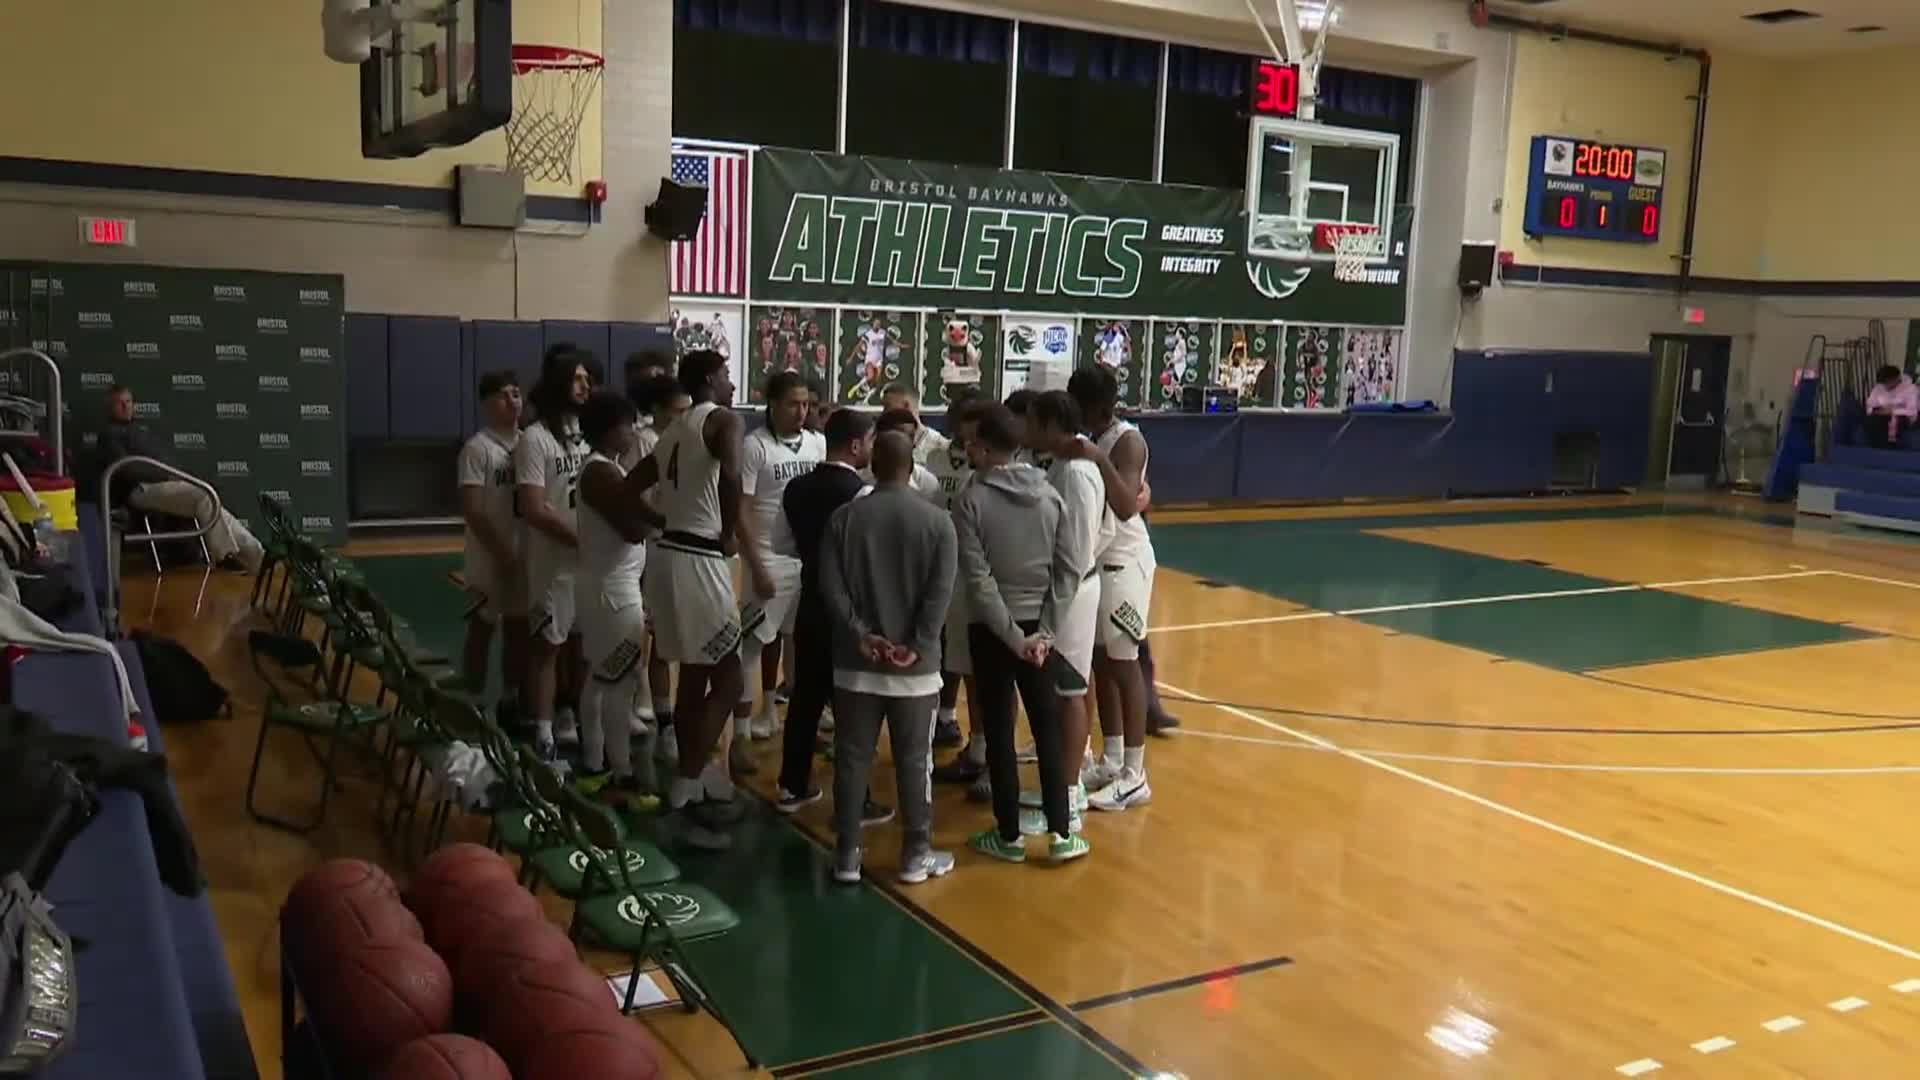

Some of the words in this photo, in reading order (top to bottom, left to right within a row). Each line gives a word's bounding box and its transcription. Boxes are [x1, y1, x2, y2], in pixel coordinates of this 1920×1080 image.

[1256, 65, 1298, 113] 30
[1575, 144, 1633, 179] 20:00
[870, 178, 957, 200] BRISTOL
[968, 187, 1069, 207] BAYHAWKS
[1629, 185, 1656, 201] GUEST
[1559, 196, 1576, 228] 0
[1599, 205, 1607, 227] 1
[1642, 204, 1658, 235] 0
[93, 219, 124, 243] EXIT
[1161, 224, 1224, 244] GREATNESS
[768, 192, 1148, 299] ATHLETICS
[1161, 256, 1221, 274] INTEGRITY
[300, 290, 329, 300] BRISTOL
[257, 318, 288, 329] BRISTOL
